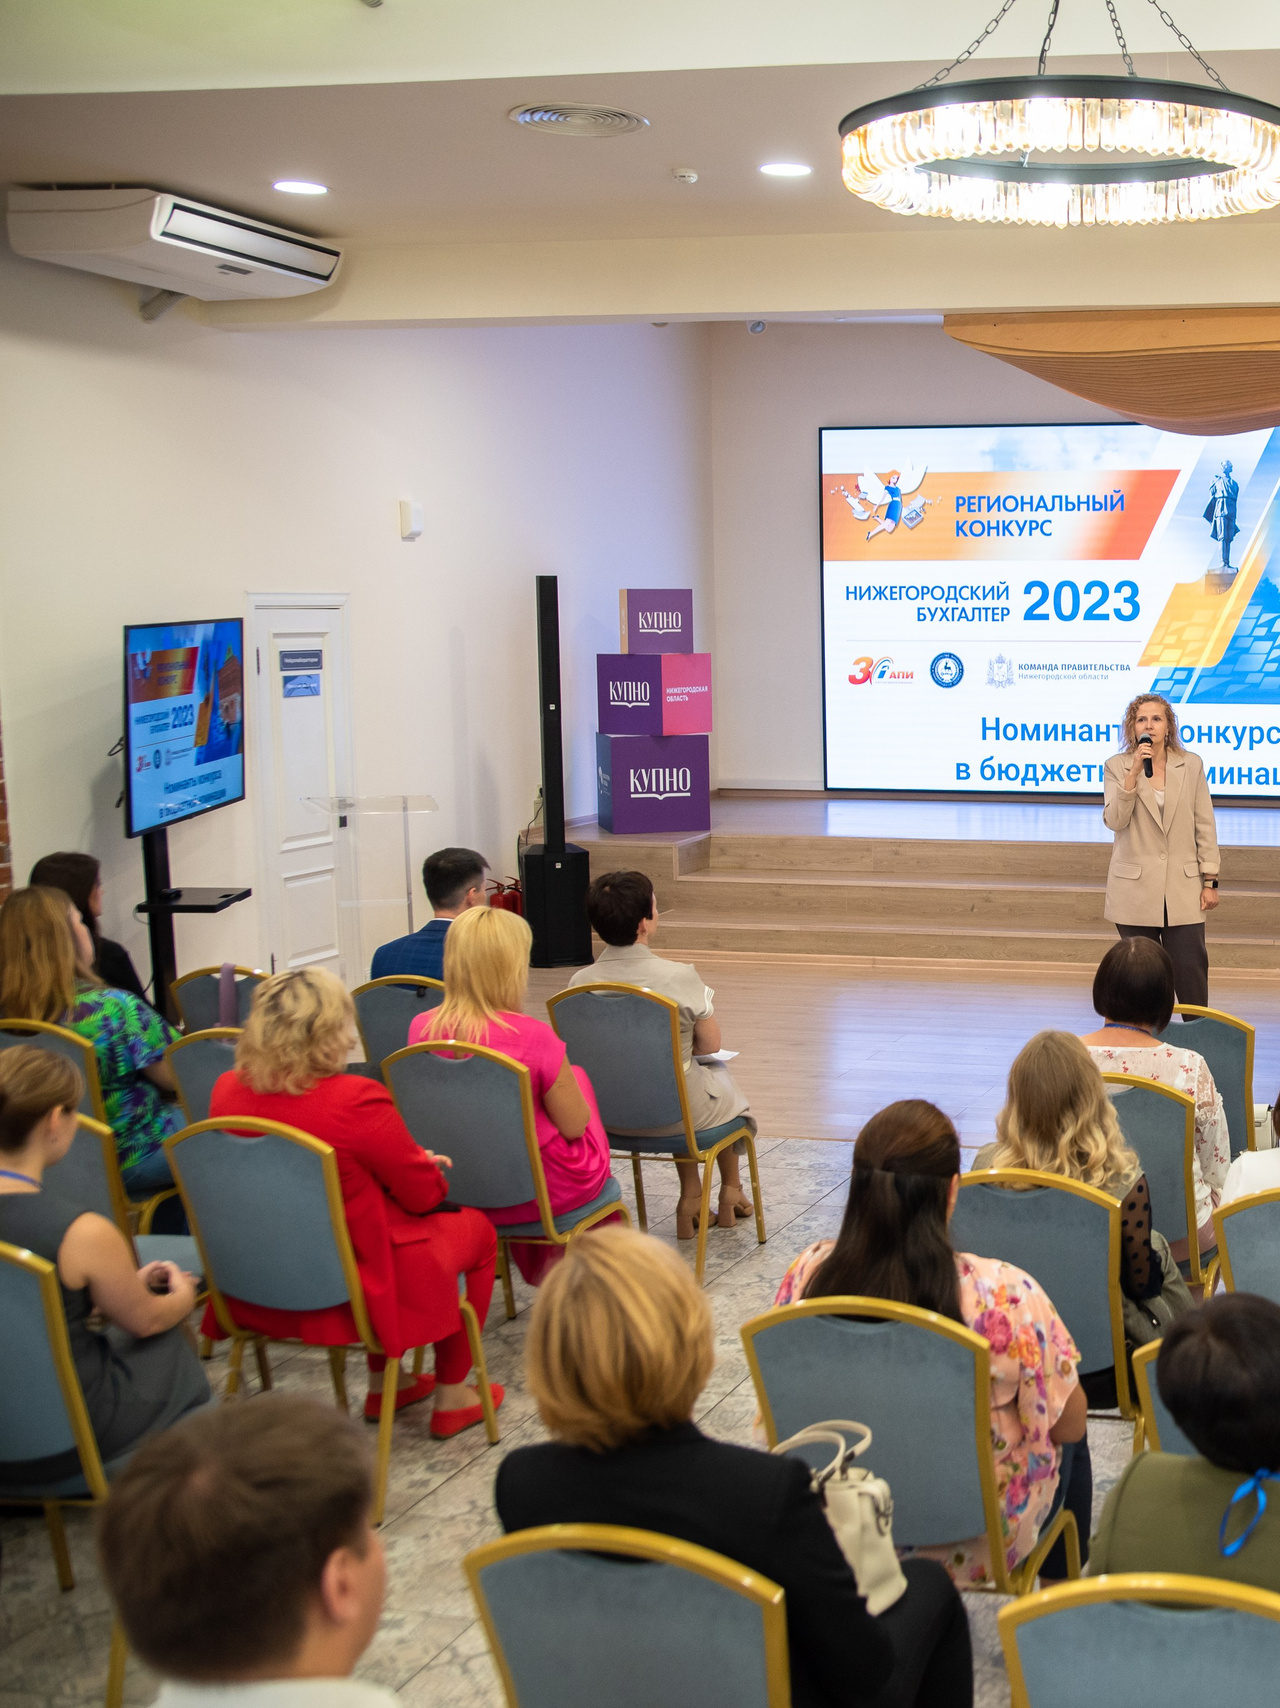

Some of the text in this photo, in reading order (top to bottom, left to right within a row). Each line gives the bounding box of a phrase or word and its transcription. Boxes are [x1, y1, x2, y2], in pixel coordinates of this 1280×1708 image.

[955, 489, 1126, 513] РЕГИОНАЛЬНЫЙ
[955, 519, 1053, 537] КОНКУРС
[844, 580, 1011, 604] НИЖЕГОРОДСКИЙ
[1023, 579, 1141, 622] 2023
[638, 611, 682, 629] КУПНО
[916, 606, 1011, 623] БУХГАЛТЕР
[889, 671, 914, 679] АПИ
[1018, 663, 1131, 672] КОМАНДА ПРАВИТЕЛЬСТВА
[1018, 672, 1109, 681] Нижегородской области
[609, 681, 650, 701] КУПНО
[666, 685, 709, 695] НИЖЕГОРОДСКАЯ
[666, 695, 689, 703] ОБЛАСТЬ
[981, 717, 1123, 743] Номинант
[629, 767, 691, 793] КУПНО
[955, 762, 972, 780] в
[979, 756, 1105, 787] бюджет
